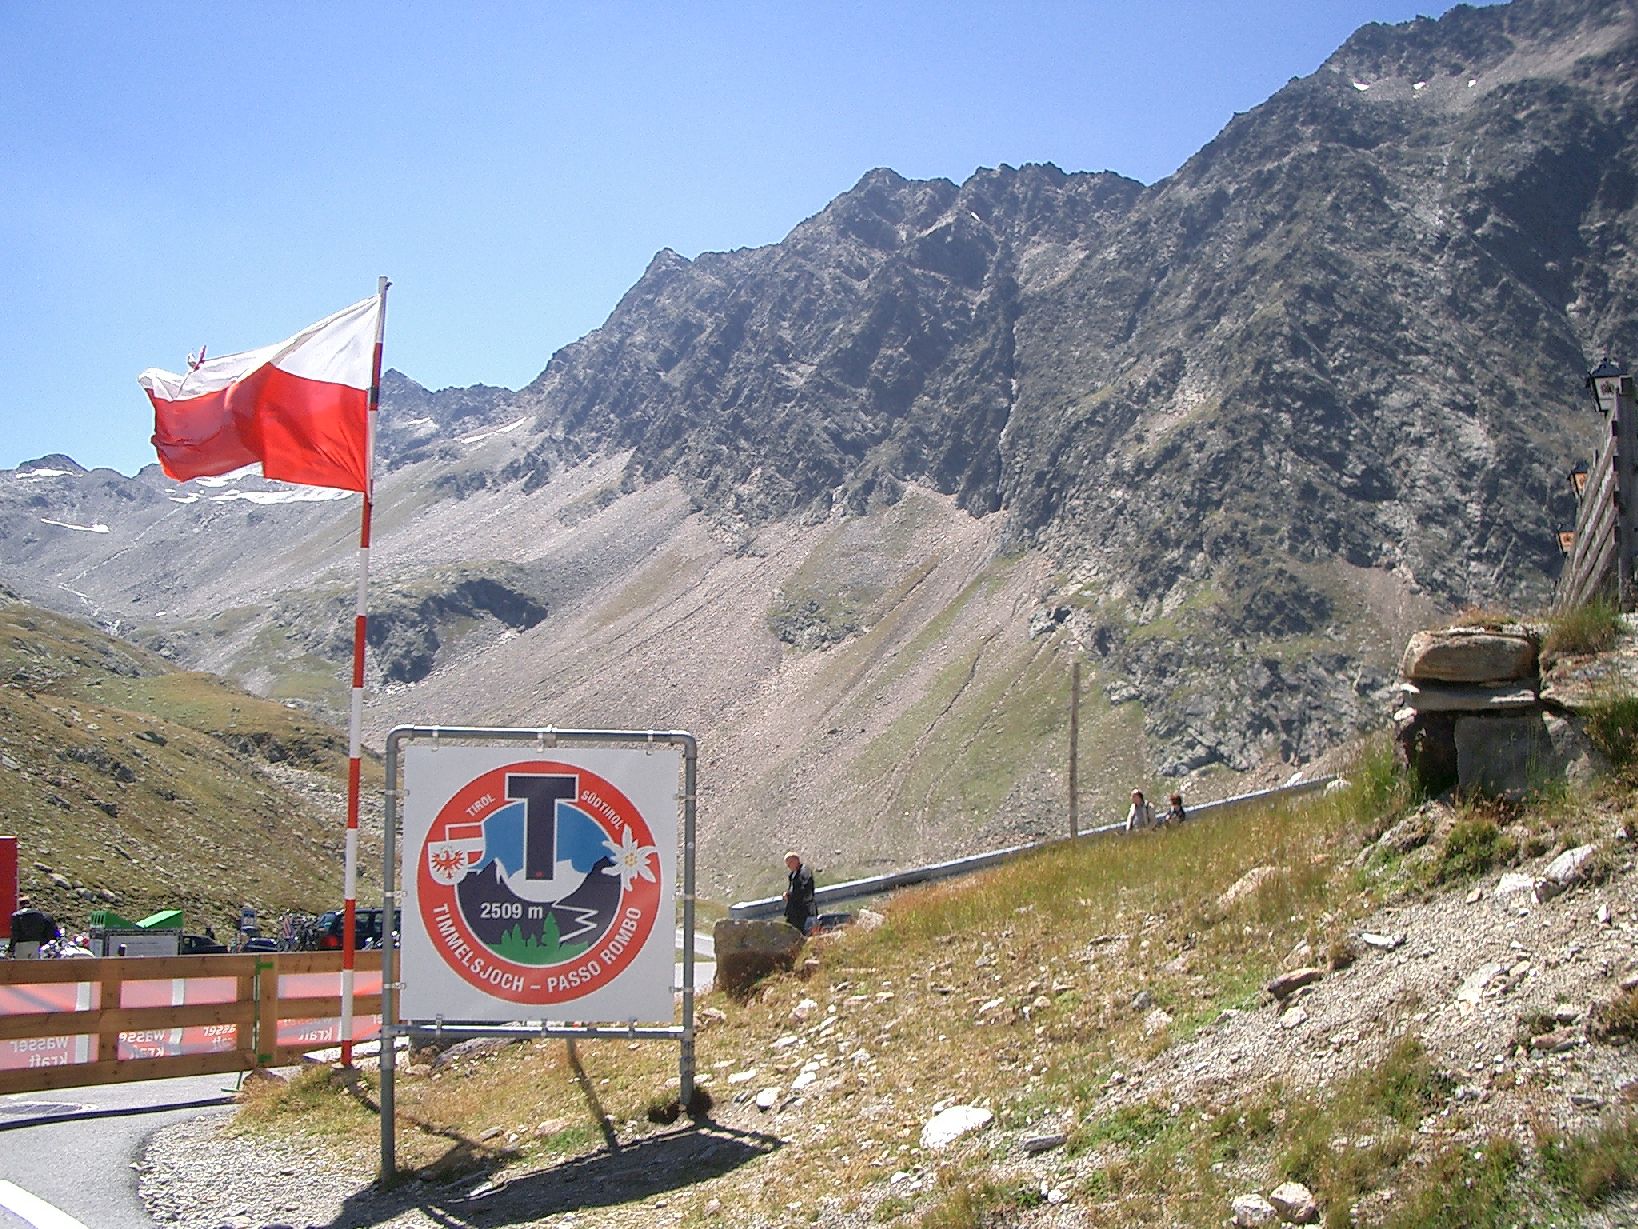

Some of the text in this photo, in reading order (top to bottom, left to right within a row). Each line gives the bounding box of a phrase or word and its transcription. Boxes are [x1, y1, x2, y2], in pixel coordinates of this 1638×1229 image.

[466, 794, 496, 816] TIROL
[581, 790, 626, 830] SÜDTIROL
[480, 903, 543, 919] 2509 m
[433, 904, 524, 992] TIMMELSJOCH
[547, 961, 601, 992] PASSO
[600, 907, 642, 965] ROMBO
